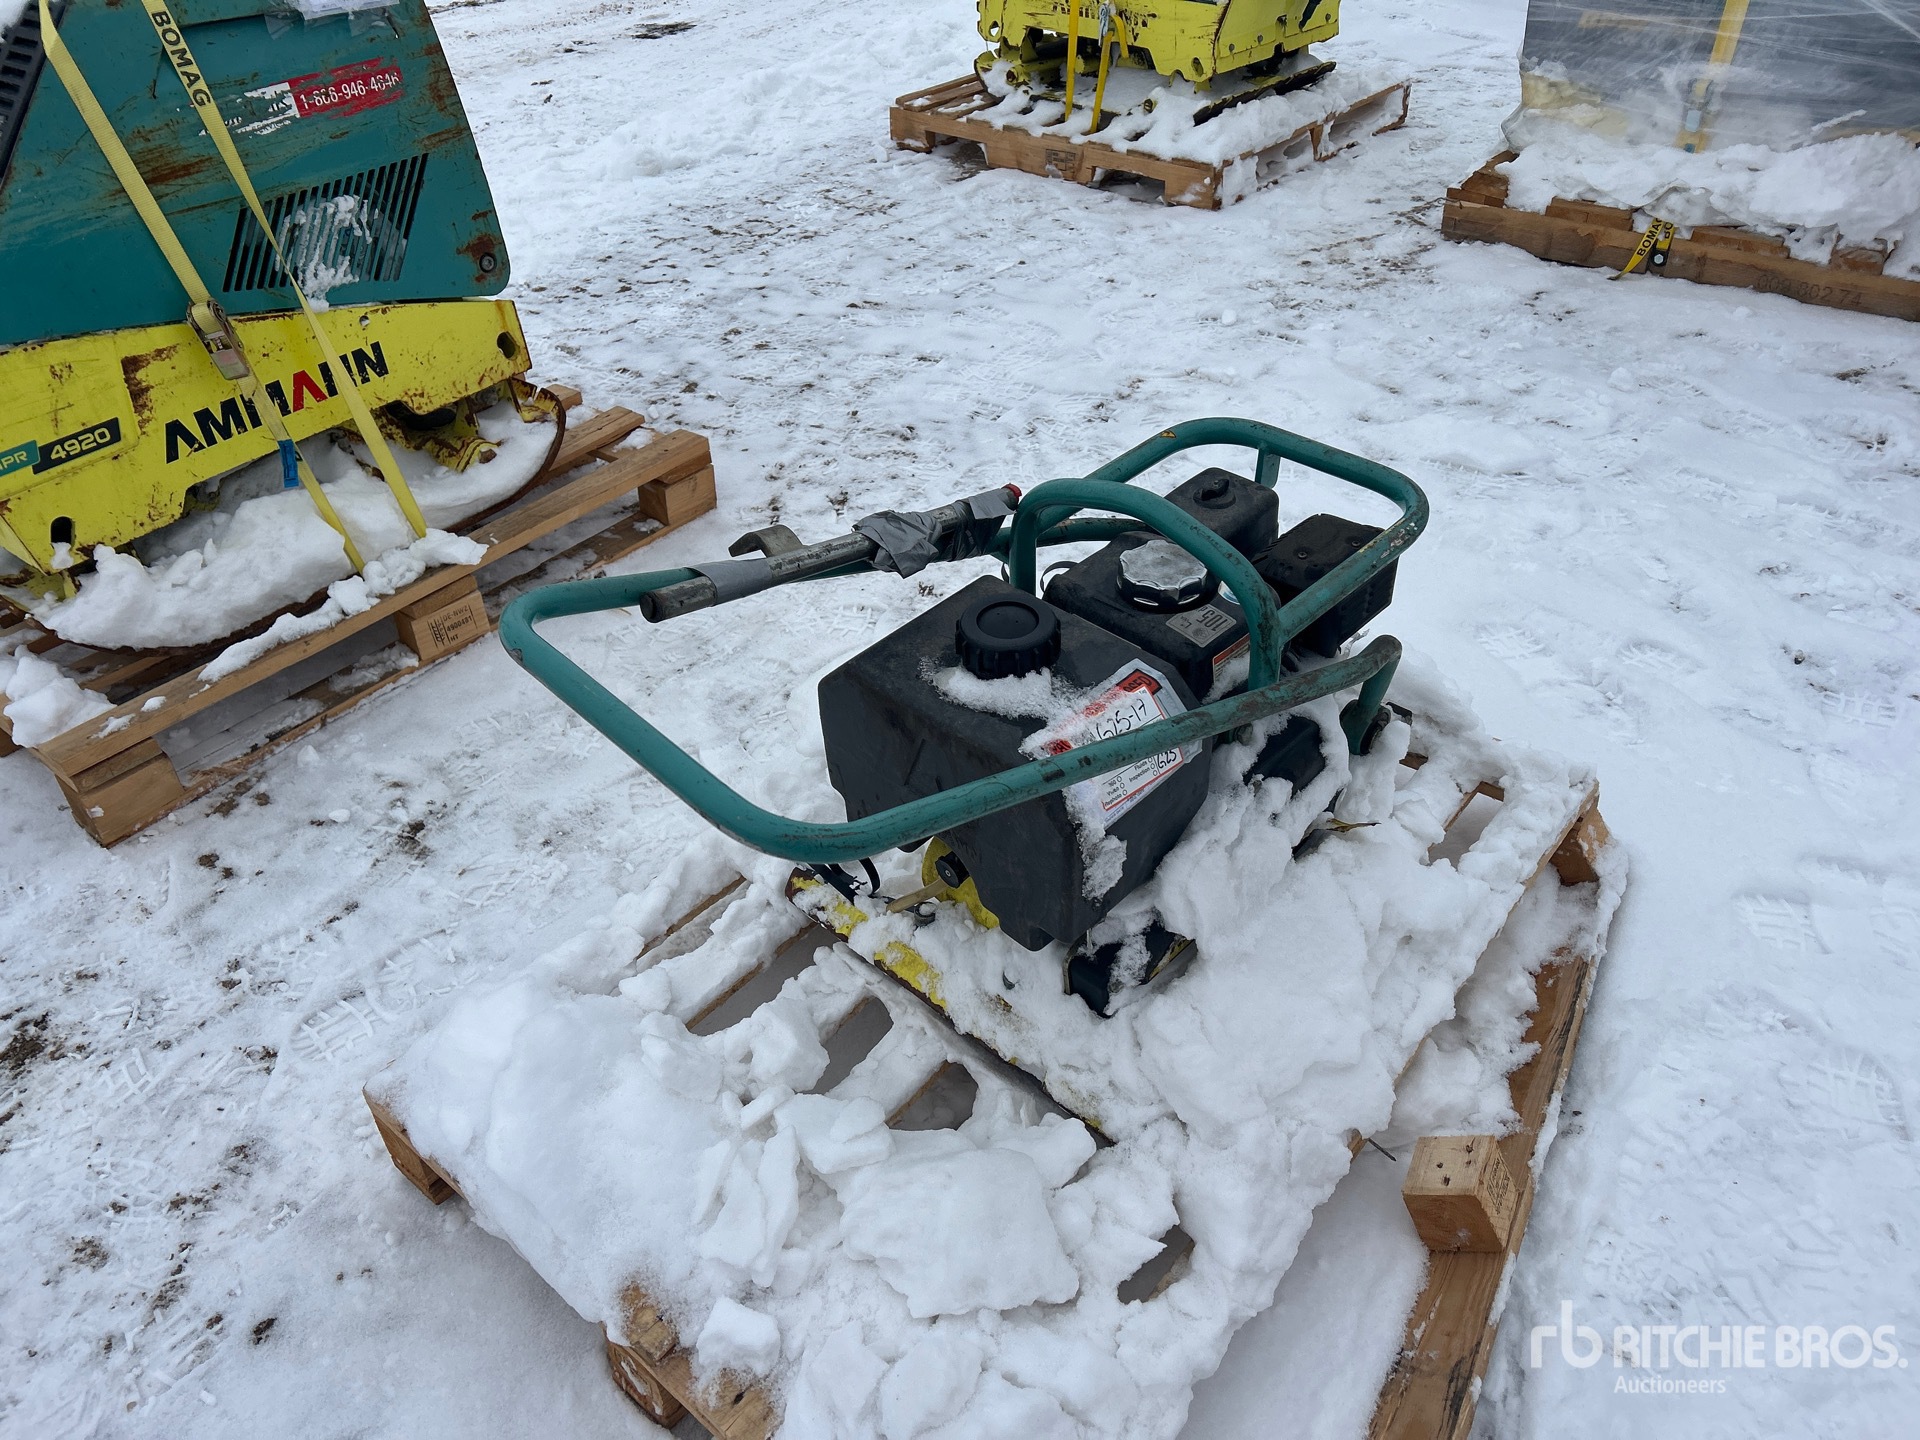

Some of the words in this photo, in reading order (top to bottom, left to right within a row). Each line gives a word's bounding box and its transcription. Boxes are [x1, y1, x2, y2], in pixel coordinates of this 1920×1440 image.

[151, 10, 212, 107] BOMAG
[164, 341, 390, 464] AMMANN
[0, 450, 28, 471] PR
[50, 427, 112, 461] 4920
[1196, 610, 1228, 631] 105
[1128, 767, 1151, 783] Inspection
